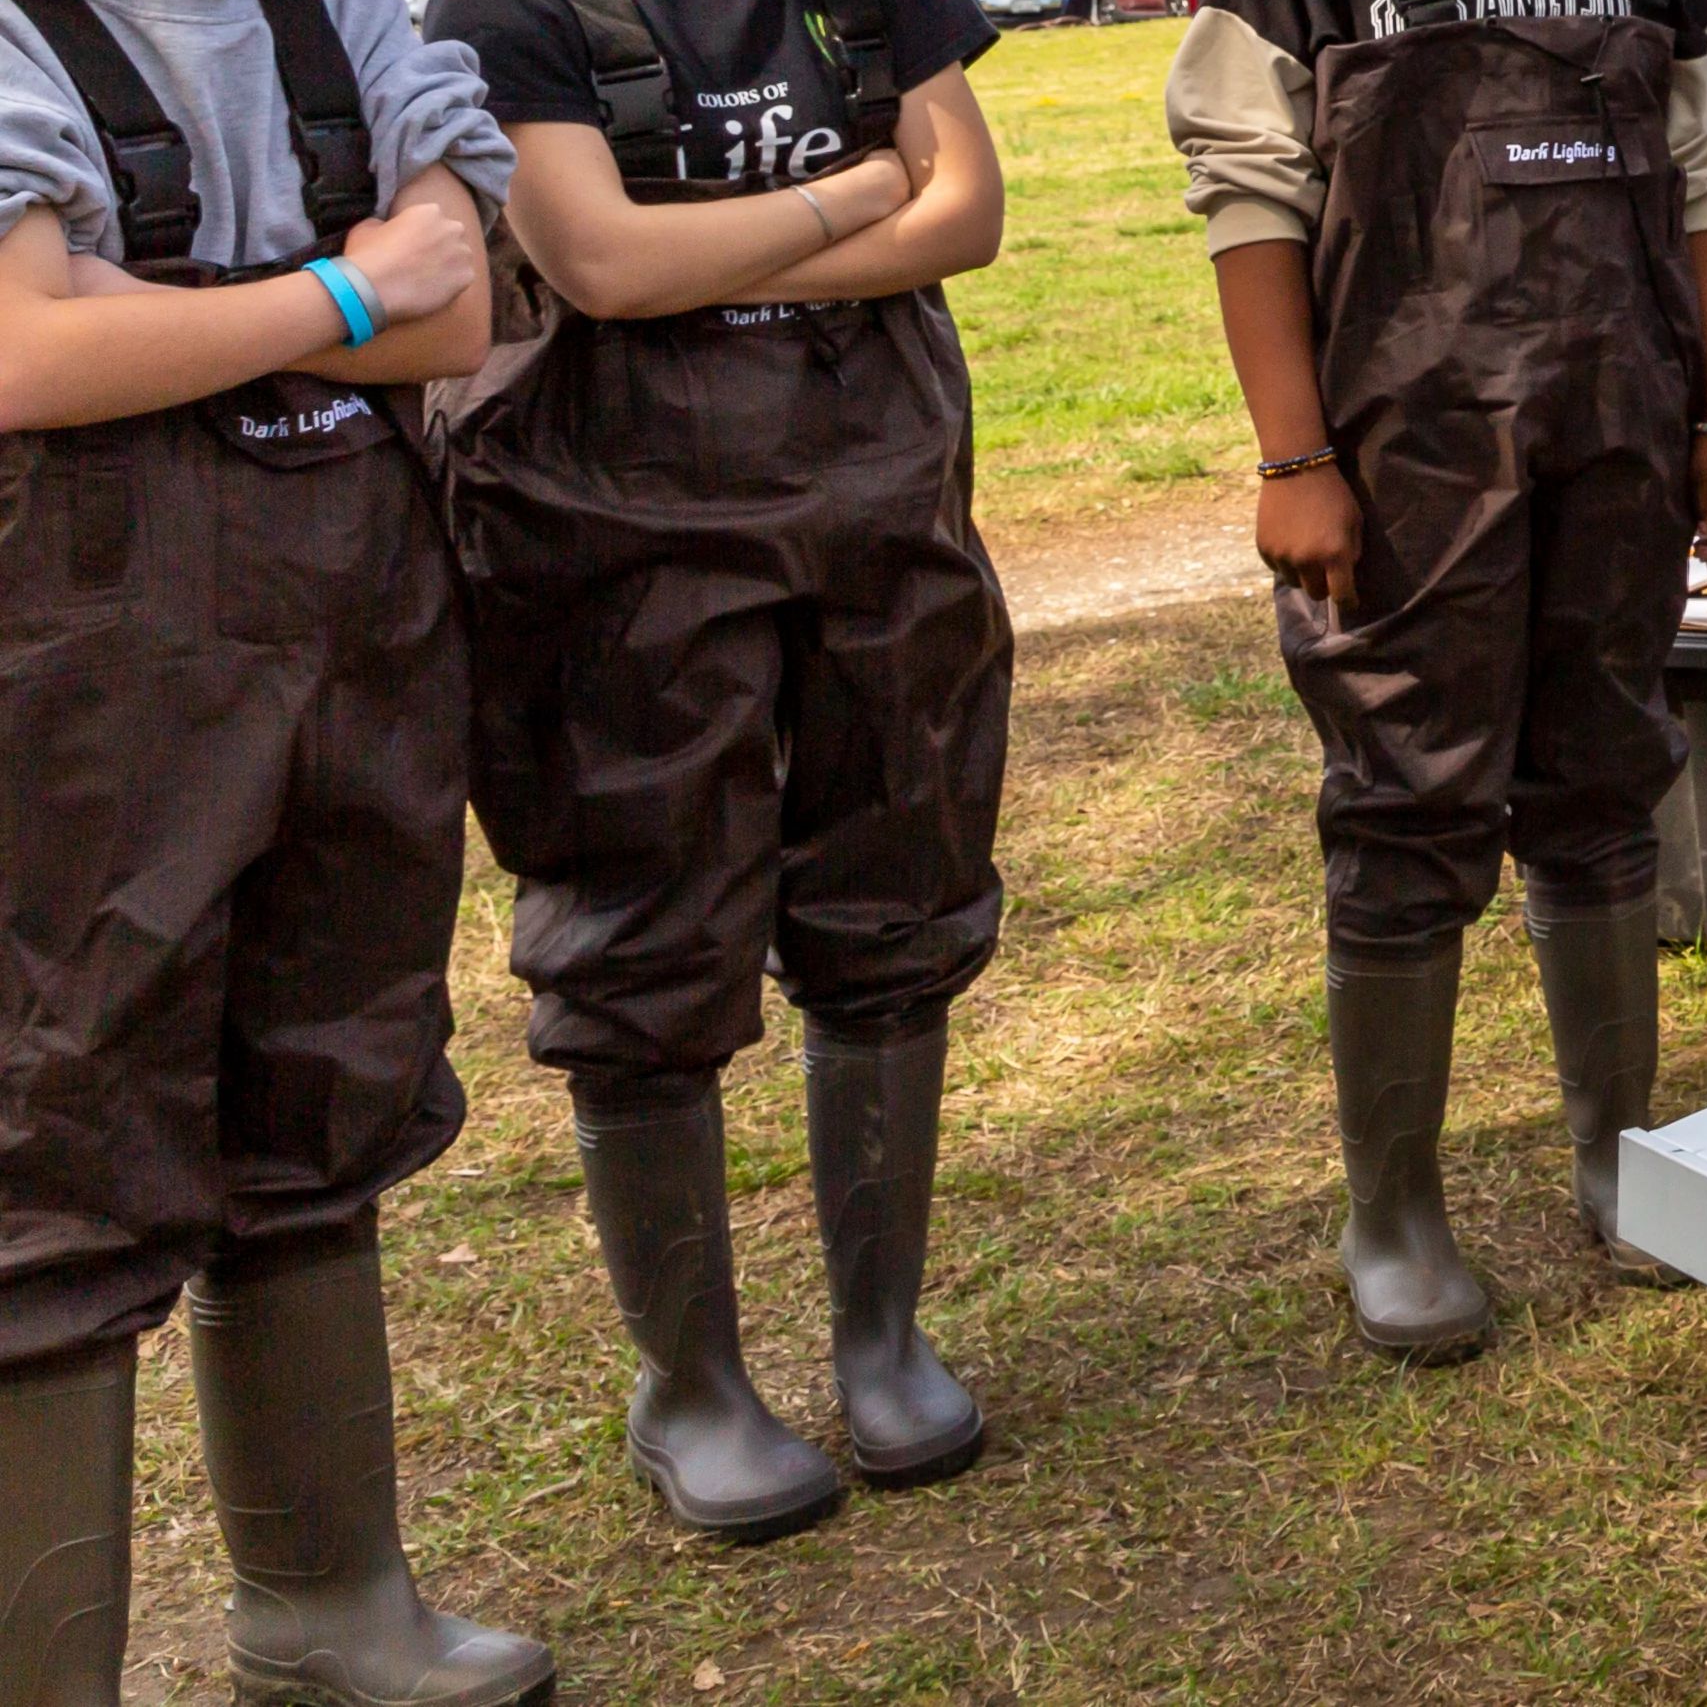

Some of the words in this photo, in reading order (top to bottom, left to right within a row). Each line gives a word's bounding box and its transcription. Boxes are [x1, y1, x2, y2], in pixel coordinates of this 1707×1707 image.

[697, 88, 760, 108] COLORS
[762, 82, 790, 100] OF
[1506, 142, 1550, 162] Dark
[1552, 140, 1615, 164] Lightnig
[722, 305, 771, 326] Dark
[240, 416, 290, 438] Dark
